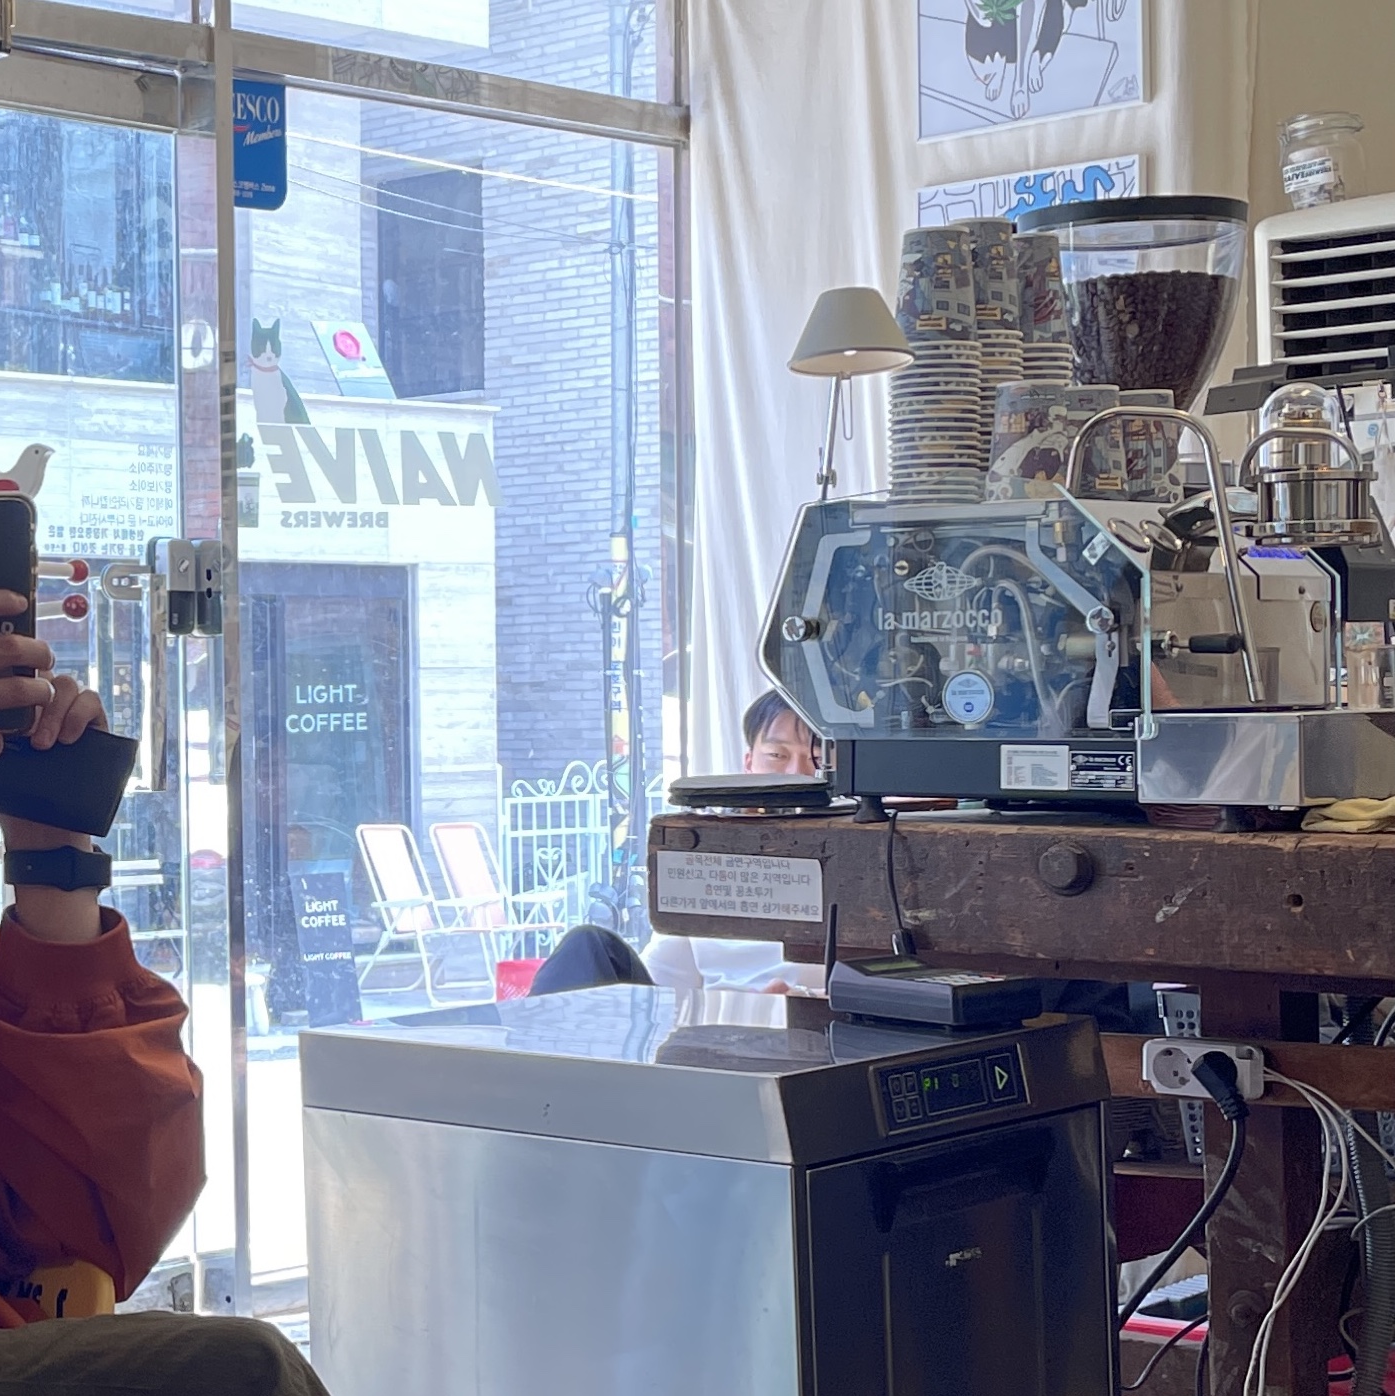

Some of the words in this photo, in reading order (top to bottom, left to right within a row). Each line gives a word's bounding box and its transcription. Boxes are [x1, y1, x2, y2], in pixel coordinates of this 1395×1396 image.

[233, 92, 280, 123] ESCO
[877, 607, 895, 631] la
[902, 608, 1003, 630] marzocco
[296, 684, 357, 704] LIGHT
[285, 712, 368, 733] COFFEE
[725, 856, 791, 869] 금연구역입니다
[763, 872, 811, 886] 지역입니다
[305, 899, 339, 912] LIGHT
[301, 913, 346, 928] COFFEE
